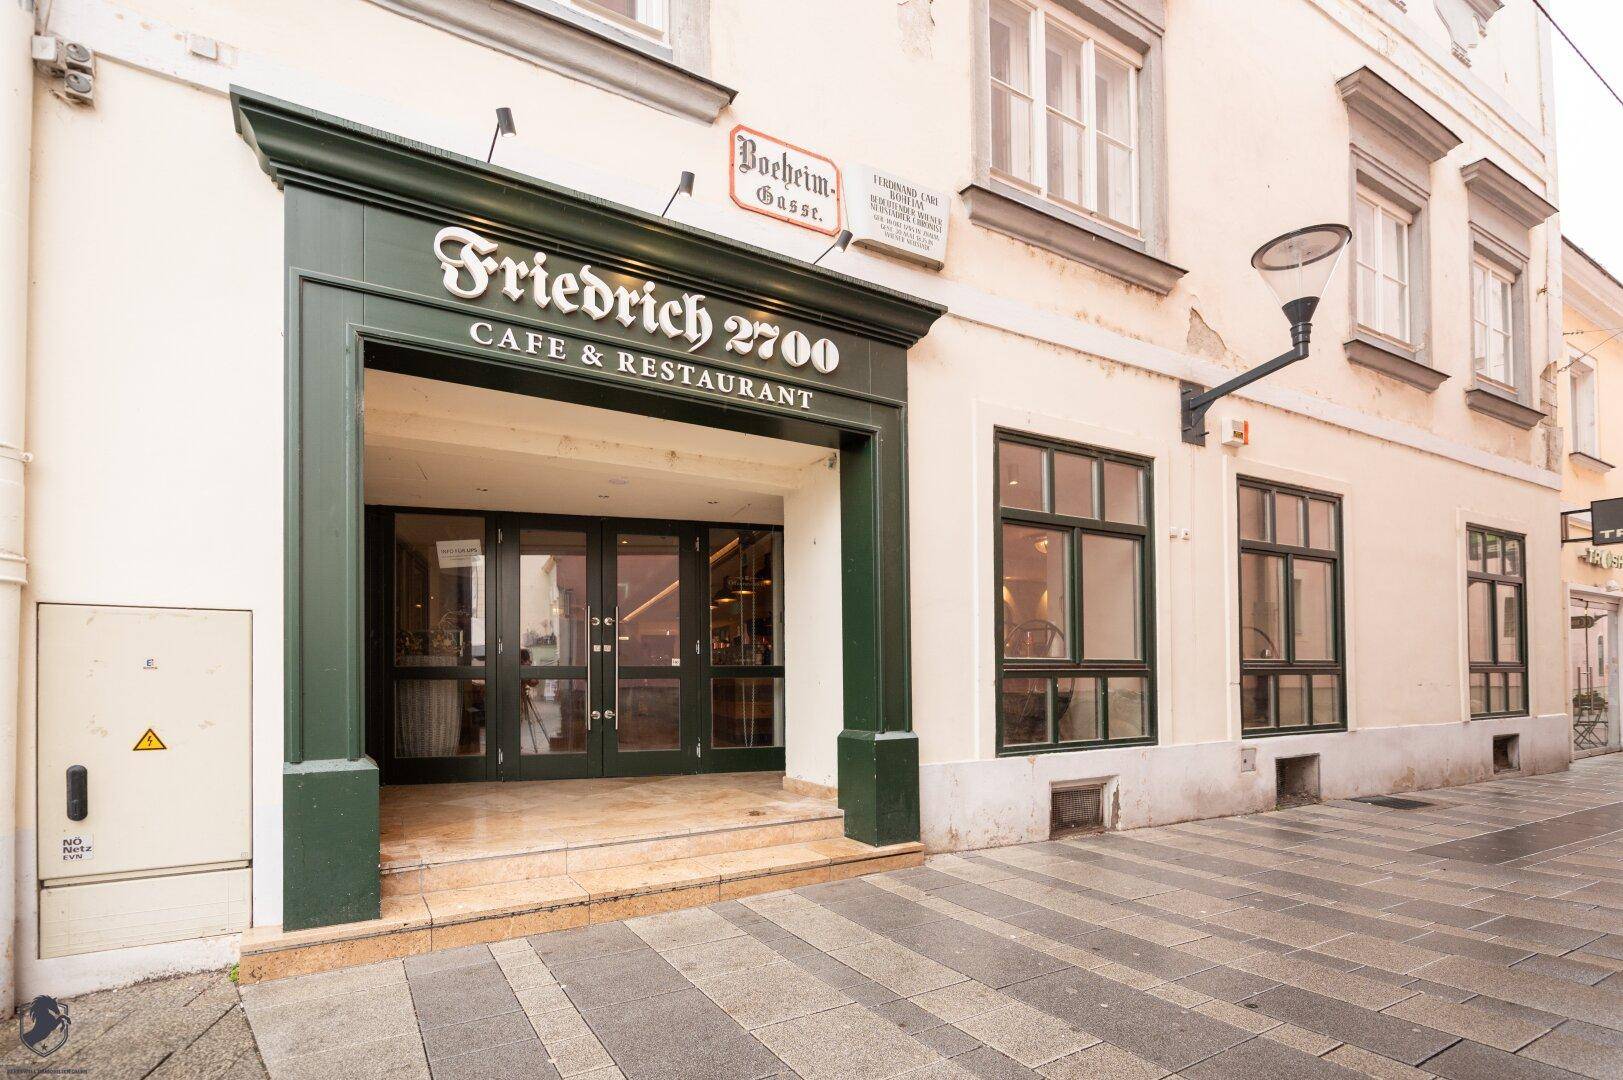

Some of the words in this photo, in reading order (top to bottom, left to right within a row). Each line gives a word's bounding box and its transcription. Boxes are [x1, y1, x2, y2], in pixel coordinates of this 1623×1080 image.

[737, 135, 836, 198] Boeheim-
[873, 174, 918, 198] FERDINAND
[756, 184, 823, 222] Gasse.
[912, 218, 943, 234] CHRONIST
[917, 211, 943, 226] WIENER
[433, 225, 713, 352] Friedrich
[723, 315, 840, 374] 2700
[469, 321, 567, 361] CAFE
[581, 344, 604, 368] &
[617, 350, 814, 409] RESTAURANT
[62, 836, 83, 846] NÖ
[62, 845, 93, 854] Netz
[62, 853, 83, 861] EVN
